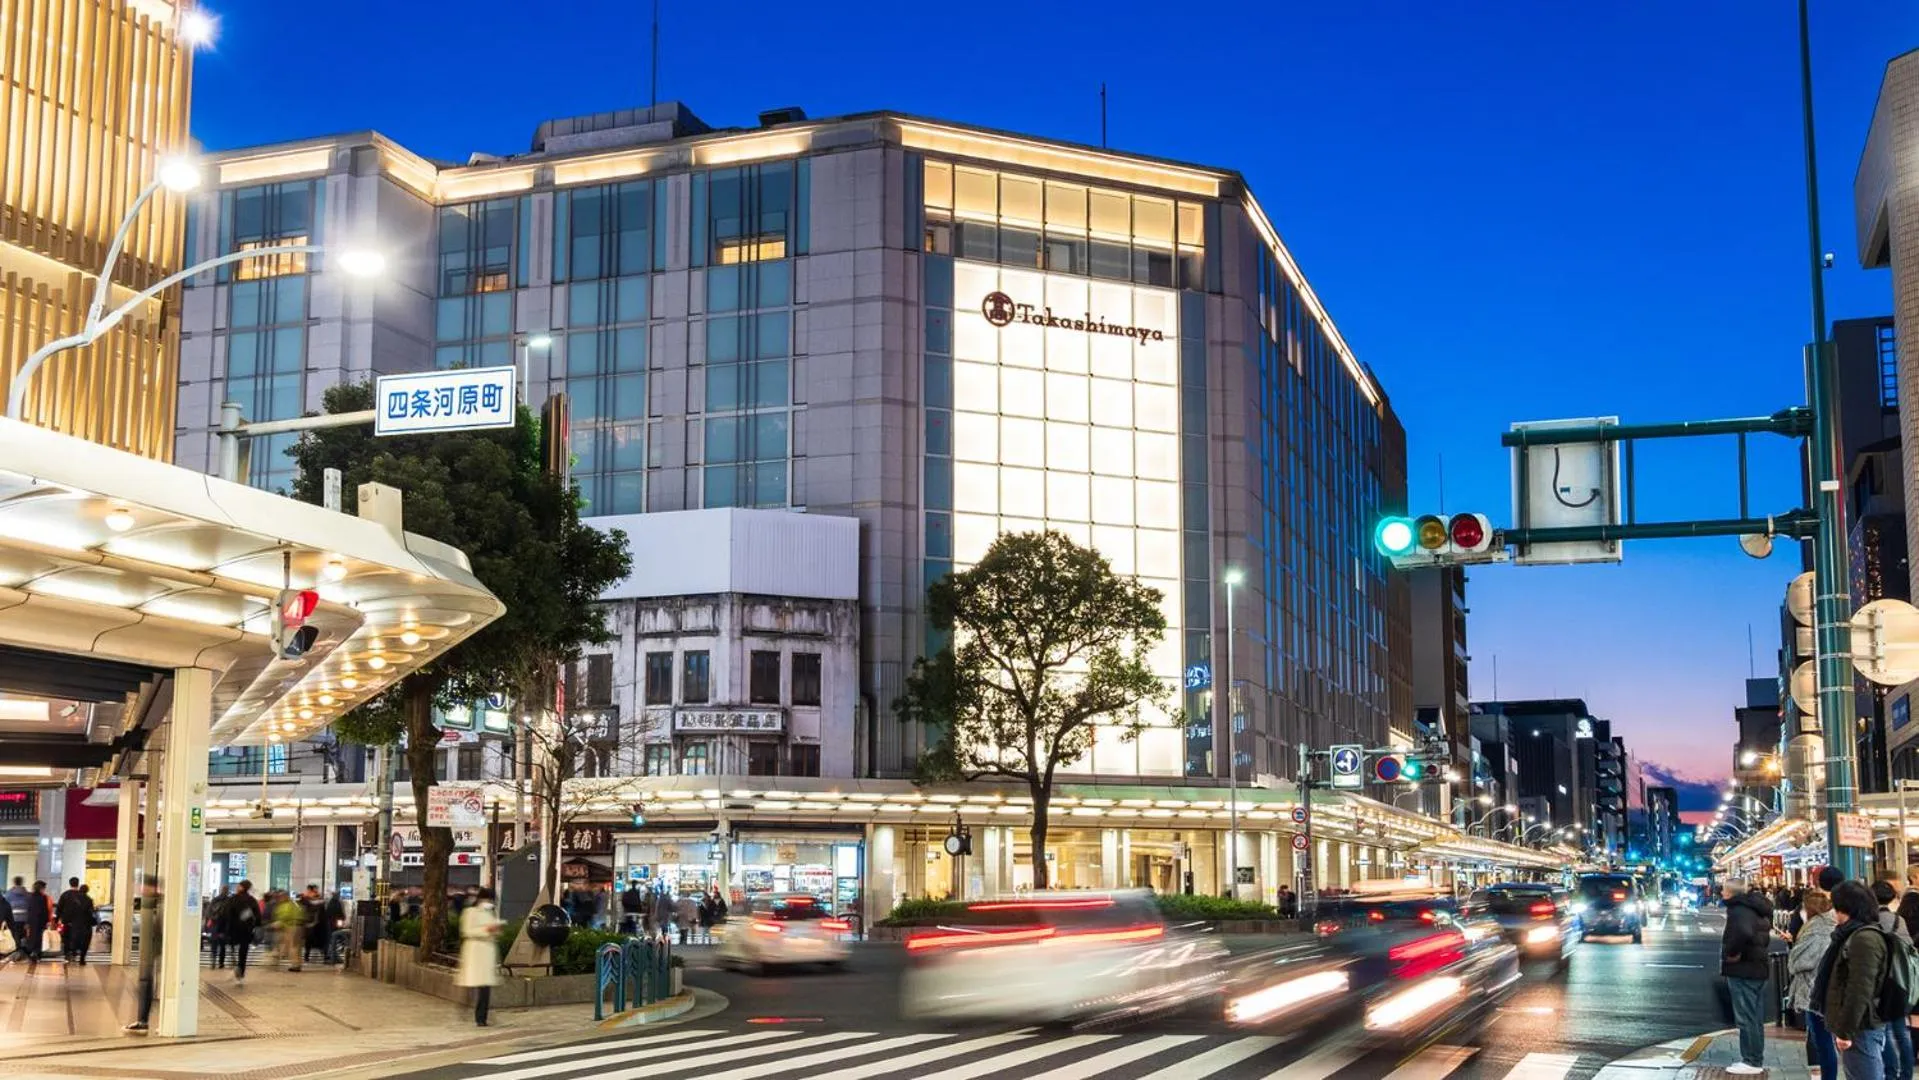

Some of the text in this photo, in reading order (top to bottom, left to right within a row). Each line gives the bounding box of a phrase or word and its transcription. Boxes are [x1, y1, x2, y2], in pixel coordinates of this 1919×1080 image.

[1017, 303, 1164, 346] Takashimaya
[387, 383, 504, 419] 四条河原町
